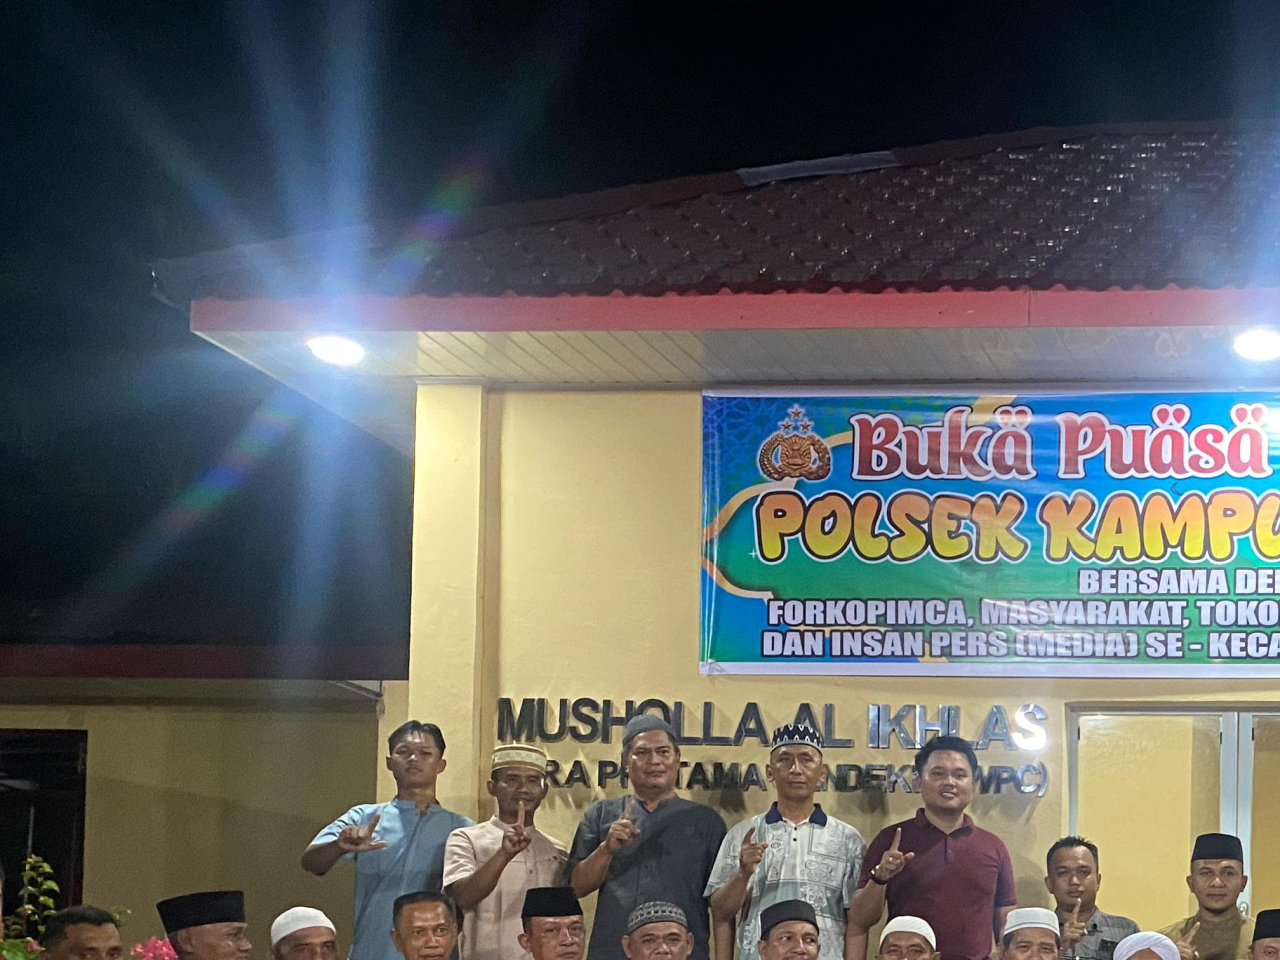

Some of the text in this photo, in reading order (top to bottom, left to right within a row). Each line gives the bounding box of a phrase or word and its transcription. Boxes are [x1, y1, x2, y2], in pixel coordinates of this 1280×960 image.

[755, 491, 1029, 562] POLSEK
[1078, 569, 1228, 595] BERSAMA
[767, 600, 974, 628] FORKOPIMCA,
[981, 600, 1190, 628] MASYARAKAT,
[762, 631, 828, 658] DAN
[831, 631, 929, 658] INSAN
[933, 631, 1008, 658] PERS
[1014, 630, 1138, 659] (MEDIA)
[1145, 631, 1184, 658] SE
[793, 702, 856, 749] AL
[867, 702, 1049, 751] IKHLAS
